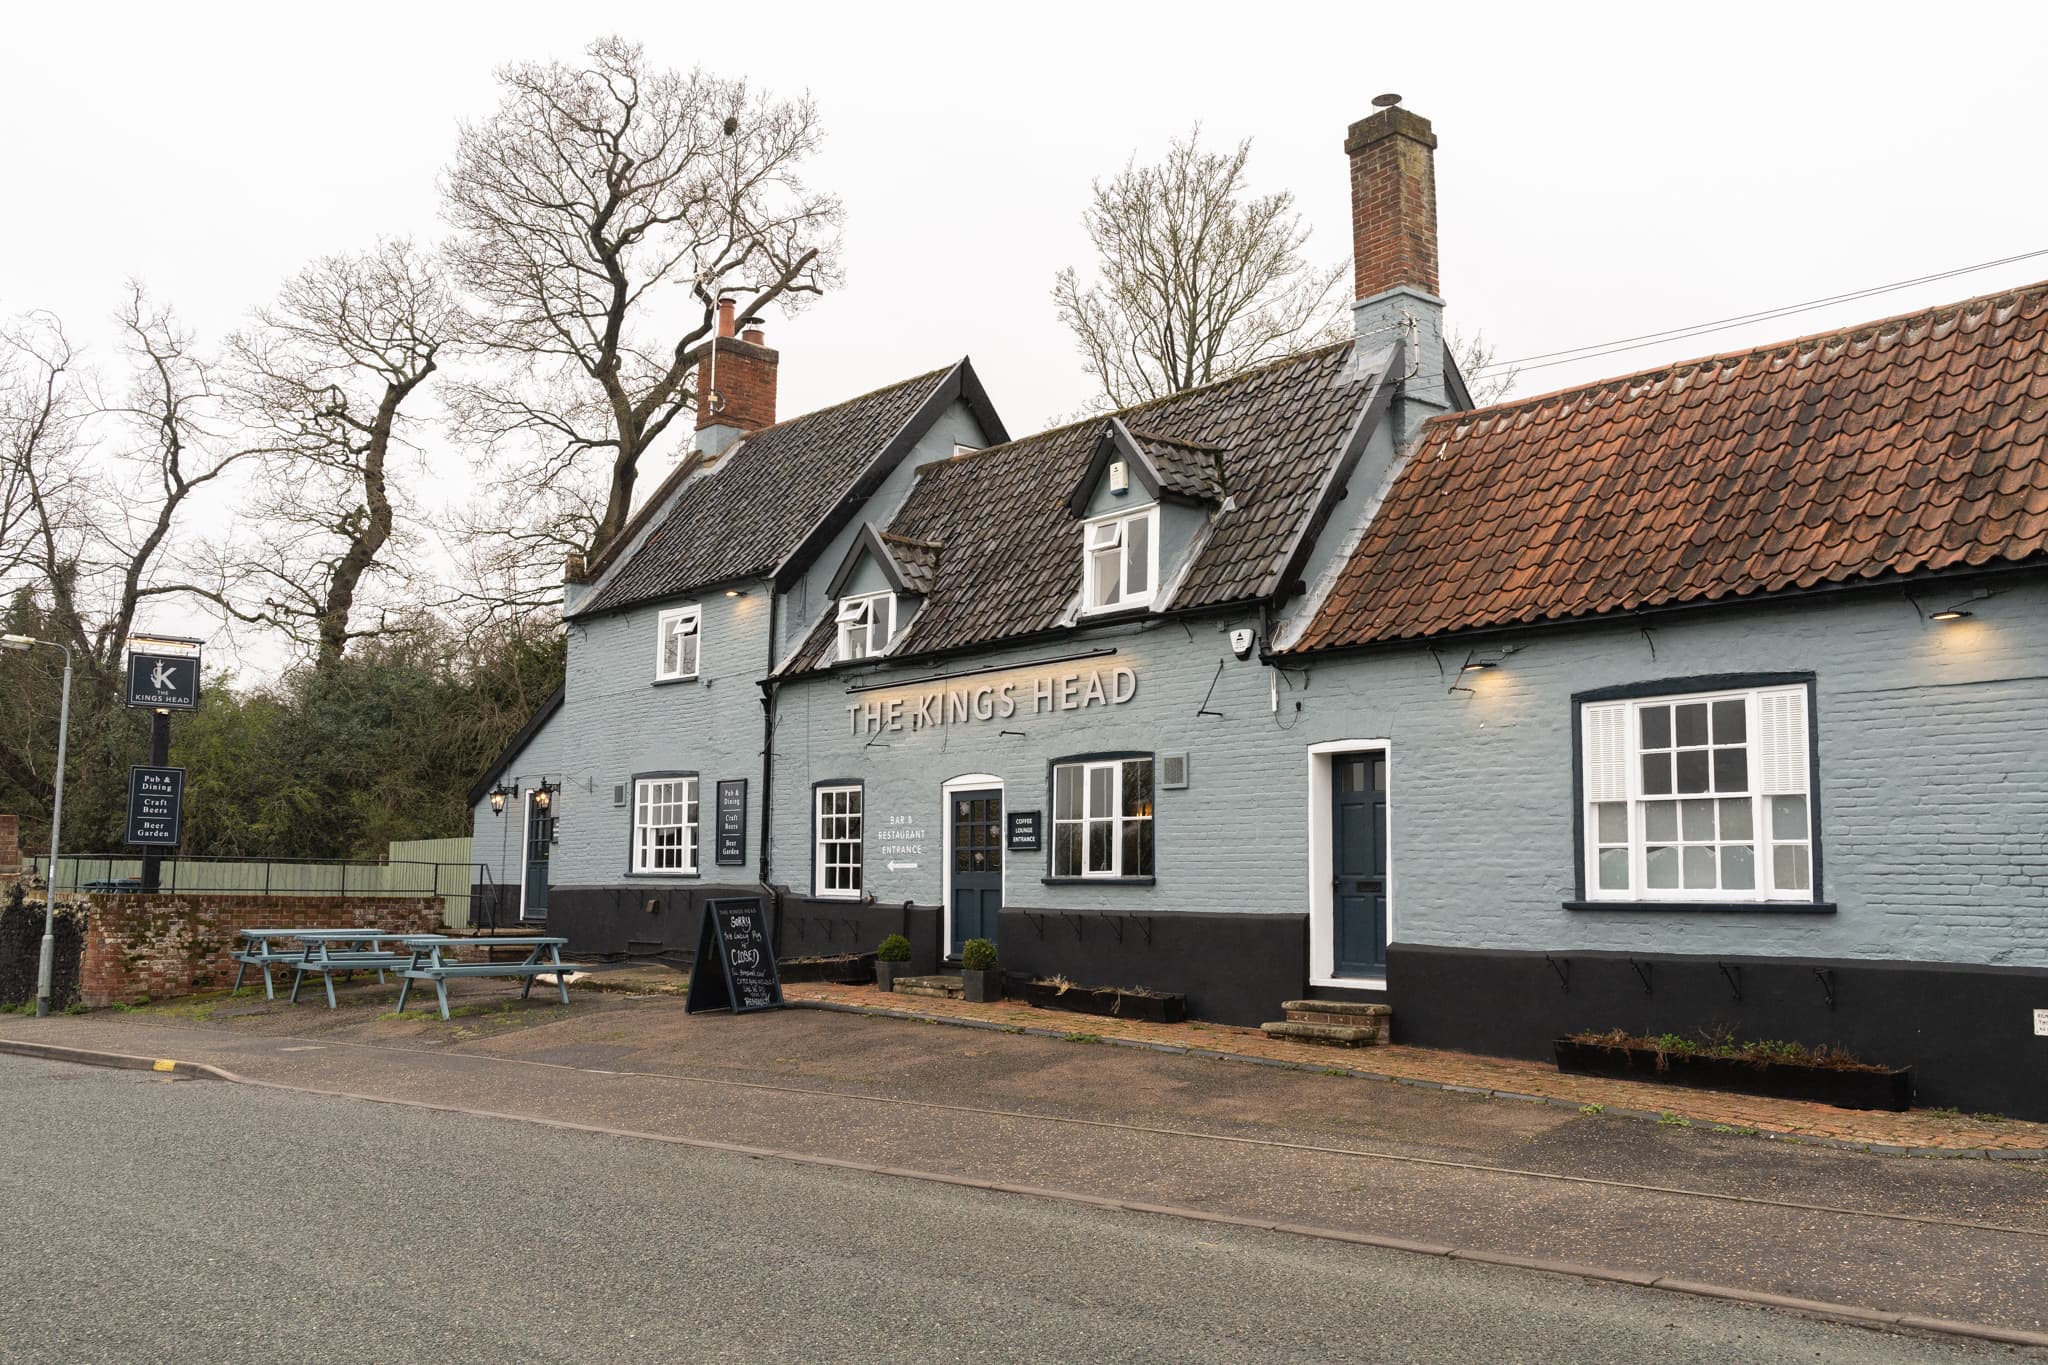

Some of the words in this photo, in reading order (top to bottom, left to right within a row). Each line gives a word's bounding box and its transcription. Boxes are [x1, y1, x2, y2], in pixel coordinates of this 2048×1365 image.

[135, 694, 163, 702] KINGS
[165, 696, 190, 704] HEAD
[846, 698, 904, 735] THE
[917, 682, 1016, 728] KINGS
[1033, 667, 1137, 713] HEAD
[144, 775, 160, 783] Pub
[164, 776, 171, 784] &
[142, 782, 172, 793] Dining
[724, 789, 735, 797] Pub
[144, 798, 168, 807] Craft
[723, 798, 741, 807] Dining
[143, 806, 168, 815] Beers
[725, 814, 739, 822] Craft
[889, 815, 906, 825] BAR
[907, 814, 913, 823] &
[1014, 817, 1034, 825] COFFEE
[144, 821, 164, 829] Beer
[137, 828, 170, 838] Garden
[1014, 826, 1034, 834] LOUNGE
[877, 829, 926, 841] RESTAURANT
[1012, 835, 1037, 844] ENTRANCE
[725, 839, 738, 847] Beer
[722, 847, 740, 856] Garden
[881, 844, 923, 855] ENTRANCE
